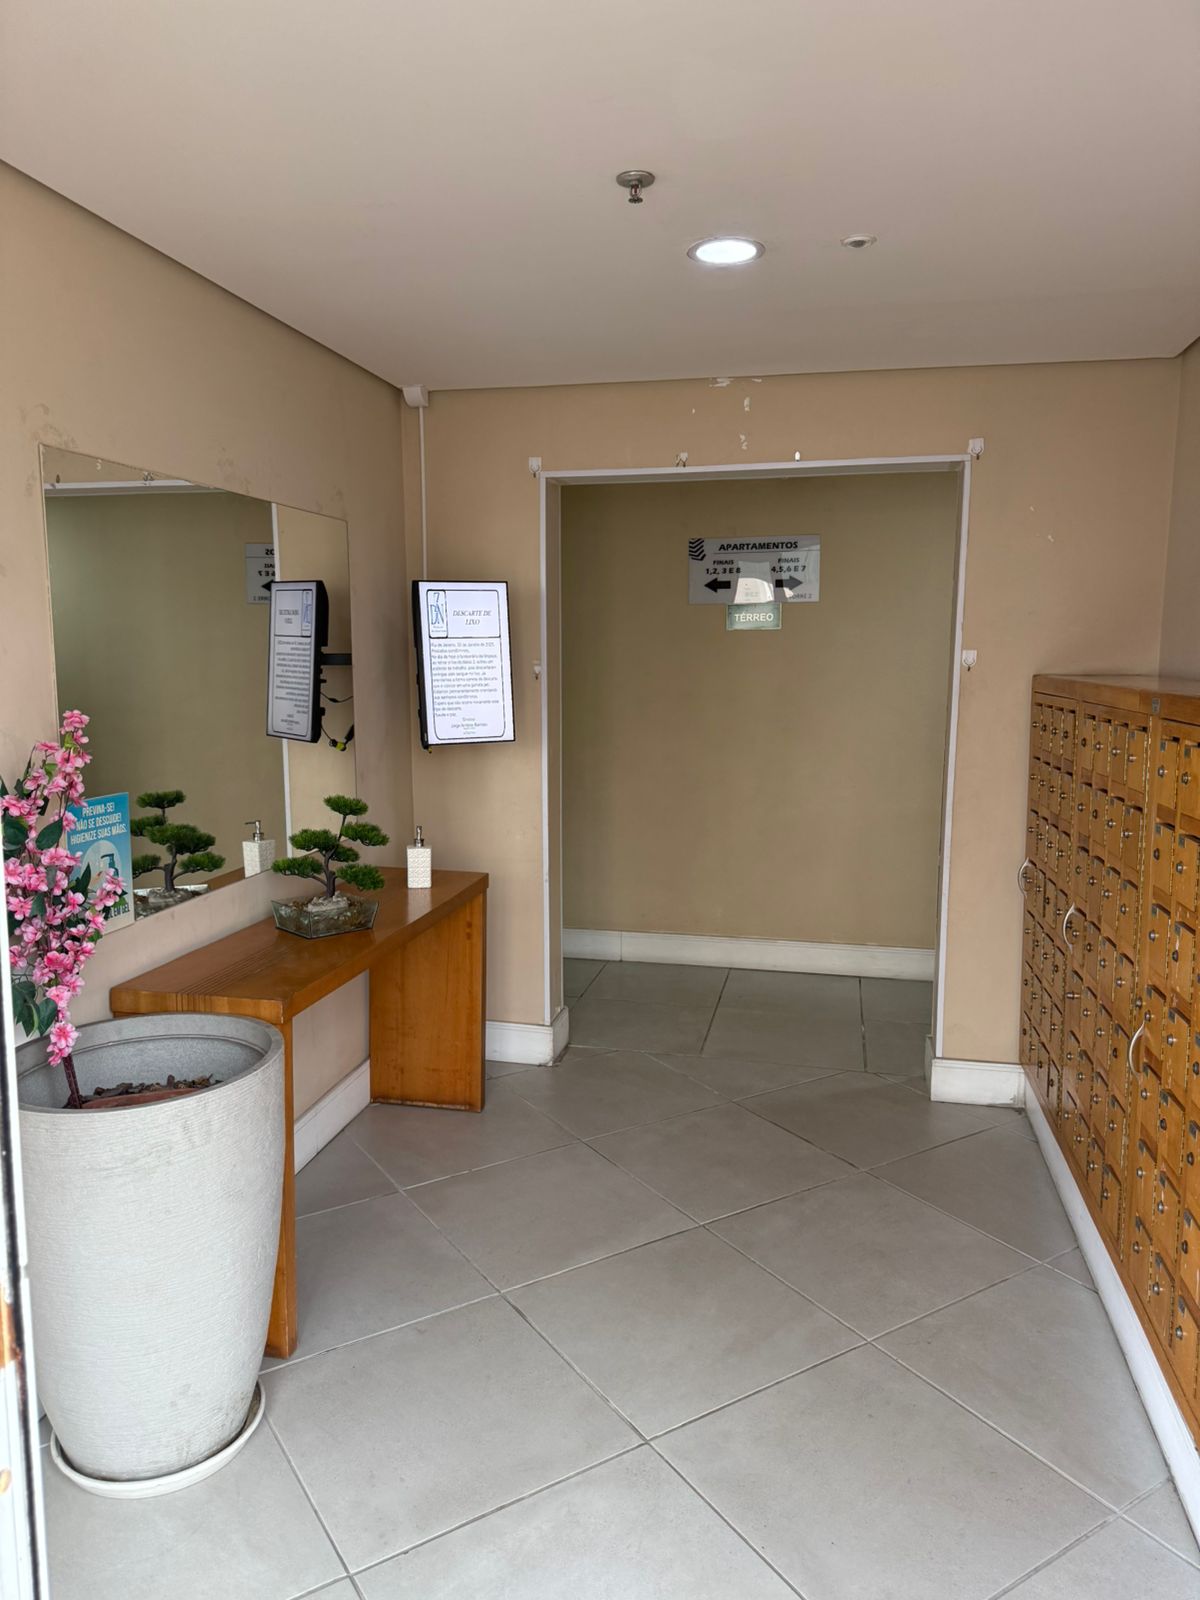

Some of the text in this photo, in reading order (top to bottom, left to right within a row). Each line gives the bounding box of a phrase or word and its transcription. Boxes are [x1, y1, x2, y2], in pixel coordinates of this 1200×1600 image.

[718, 541, 799, 552] APARTAMENTOS
[453, 609, 492, 617] DESCARTE DE
[734, 612, 774, 622] TÉRREO
[76, 818, 88, 831] NÃO
[88, 817, 95, 829] SE
[70, 829, 97, 846] HIGIENIZE
[97, 826, 111, 839] SUAS
